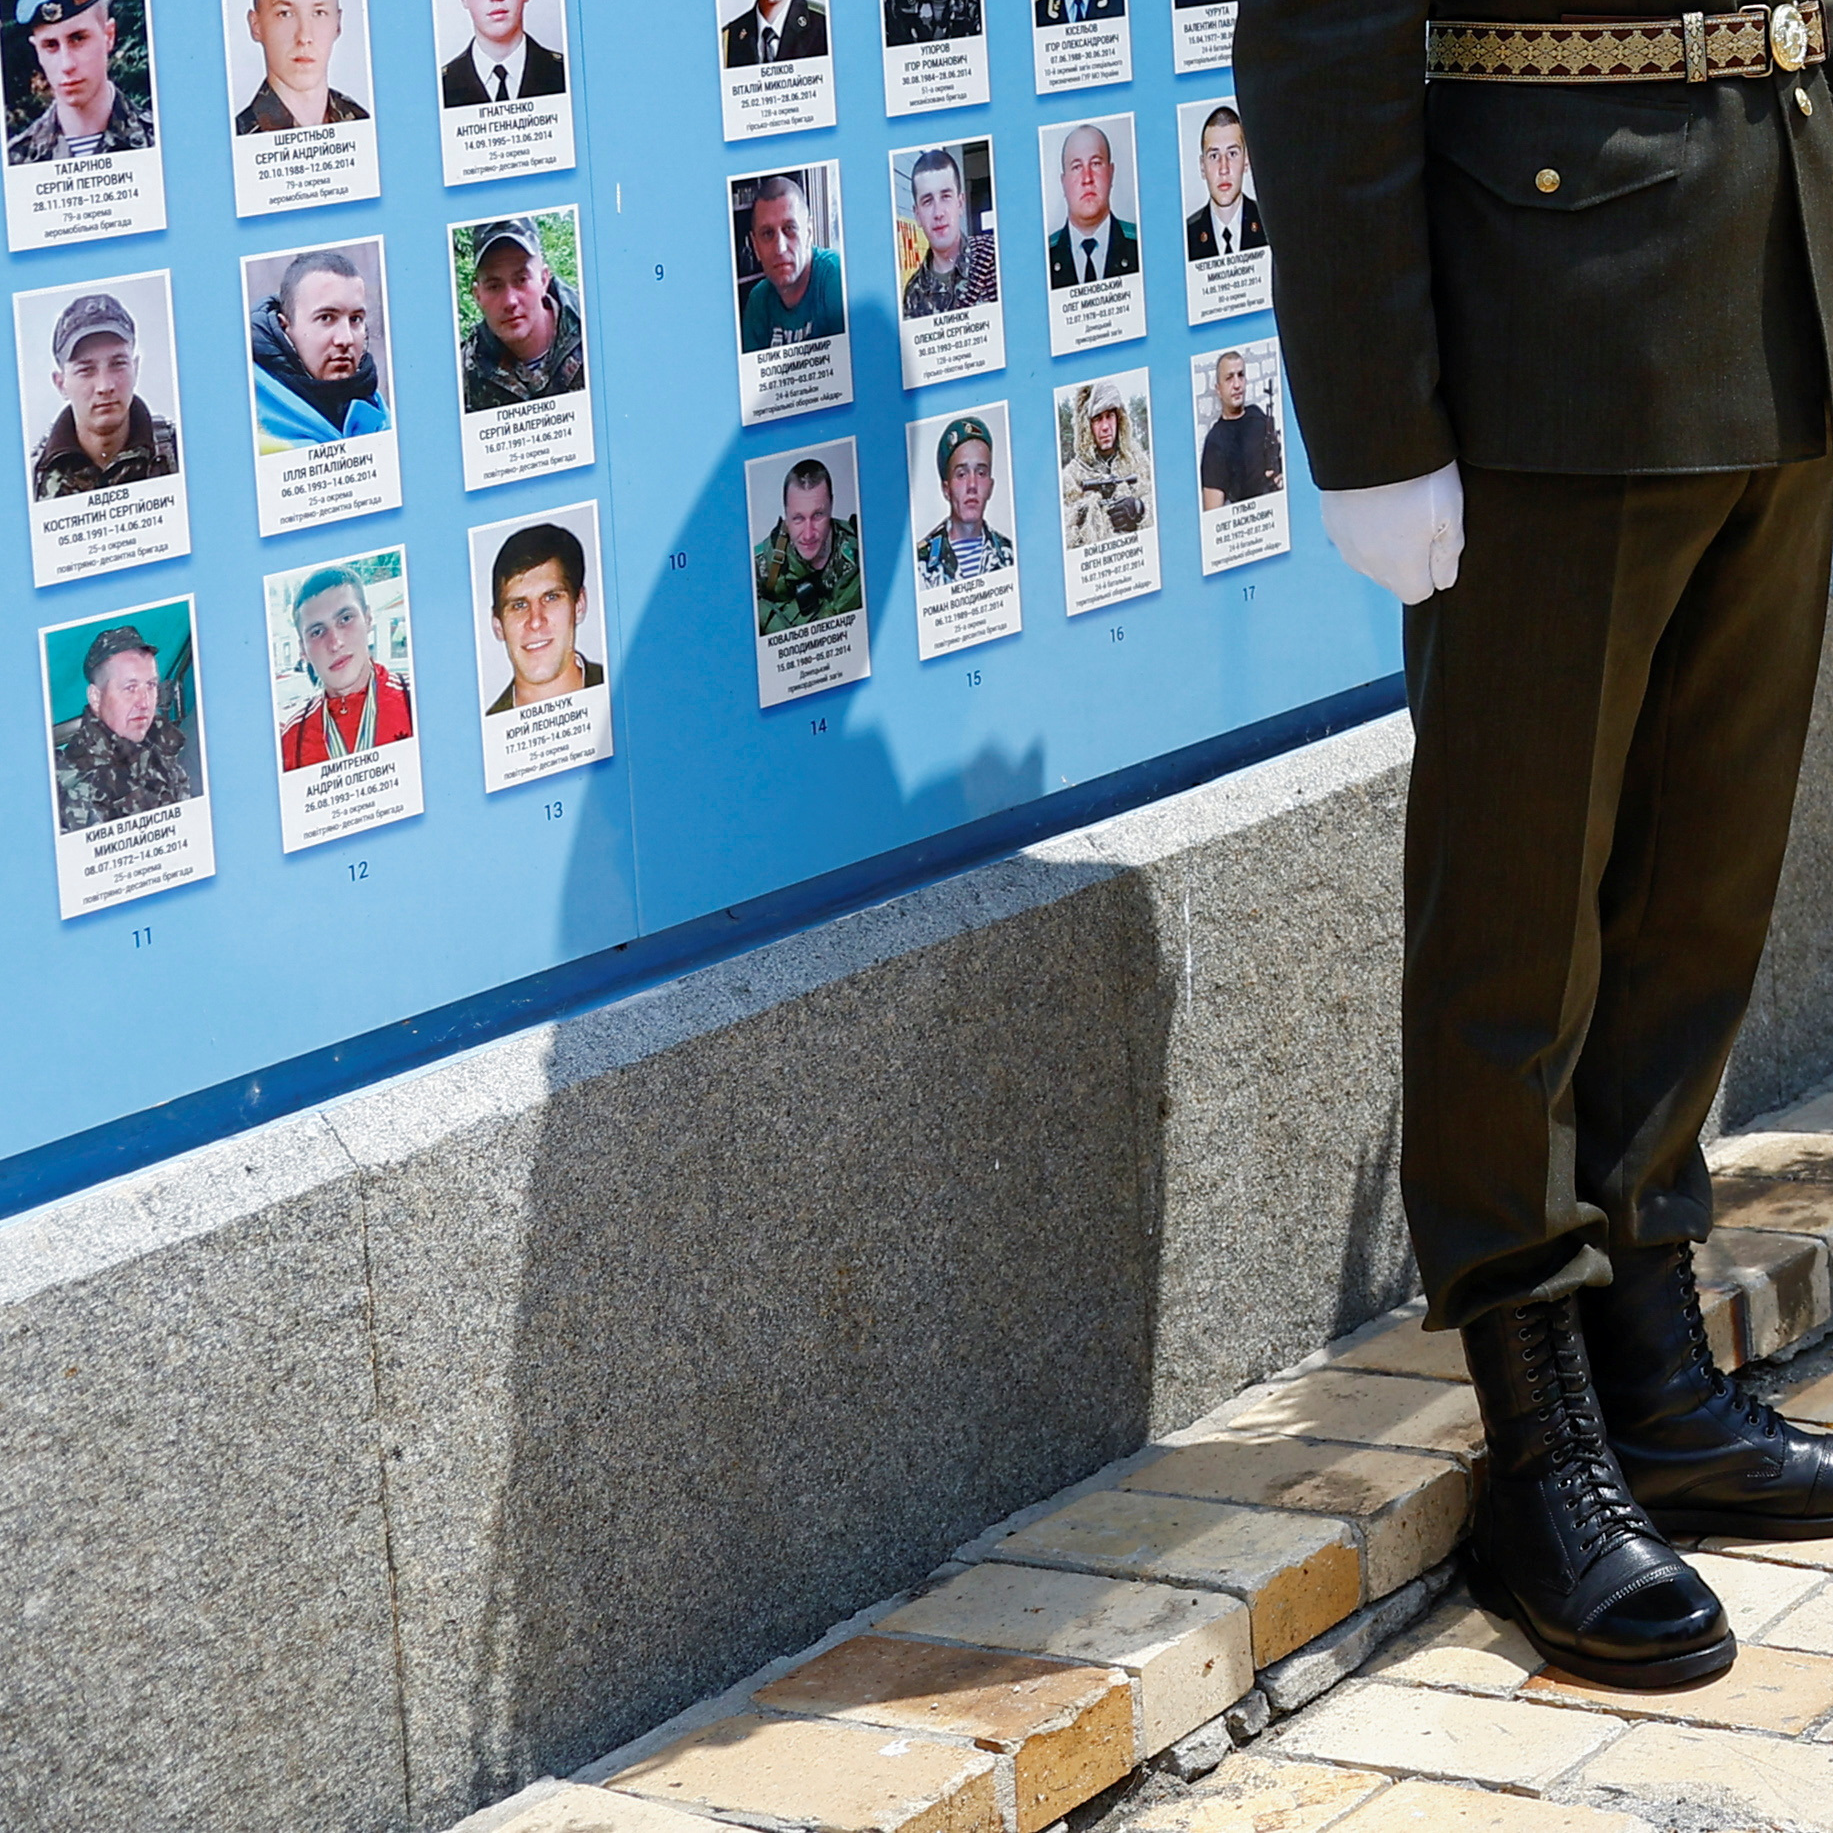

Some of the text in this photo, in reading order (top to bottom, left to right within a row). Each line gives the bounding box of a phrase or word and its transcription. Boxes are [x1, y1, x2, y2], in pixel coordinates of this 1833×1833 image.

[760, 63, 795, 78] БЄЛІКОВ
[731, 74, 824, 97] ВІТАЛІЙ МИКОЛАЙОВИЧ
[478, 101, 535, 119] ІГНАТЧЕНКО
[456, 113, 558, 137] АНТОН ГЕННАДІЙОВИЧ
[273, 127, 336, 147] ШЕРСТНЬОВ
[255, 141, 356, 166] СЕРГІЙ АНДРІЙОВИЧ
[655, 265, 664, 281] 9
[756, 339, 832, 365] БІЛИК ВОЛОДИМИР
[760, 354, 831, 379] ВОЛОДИМИРОВИЧ
[496, 399, 557, 422] ГОНЧАРЕНКО
[479, 411, 575, 441] СЕРГІЙ ВАЛЕРІЙОВИЧ
[307, 442, 347, 461] ГАЙДУК
[283, 453, 374, 483] ІЛЛЯ ВІТАЛІЙОВИЧ
[87, 487, 130, 508] АВДЄЄВ
[43, 495, 175, 534] КОСТЯНТИН СЕРГІЙОВИЧ
[669, 553, 687, 570] 10
[1243, 586, 1257, 602] 17
[767, 613, 856, 648] КОВАЛЬОВ ОЛЕКСАНДР
[1110, 626, 1126, 643] 16
[777, 630, 848, 660] ВОЛОДИМИРОВИЧ
[966, 670, 982, 688] 15
[519, 696, 573, 721] КОВАЛЬЧУК
[505, 707, 589, 740] ЮРІЙ ЛЕОНІДОВИЧ
[810, 717, 828, 736] 14
[320, 750, 380, 780] ДМИТРЕНКО
[306, 762, 396, 798] АНДРІЙ ОЛЕГОВИЧ
[544, 801, 564, 821] 13
[85, 806, 182, 843] КИВА ВЛАДИСЛАВ
[93, 824, 176, 858] МИКОЛАЙОВИЧ
[348, 861, 370, 882] 12
[132, 927, 153, 948] 11
